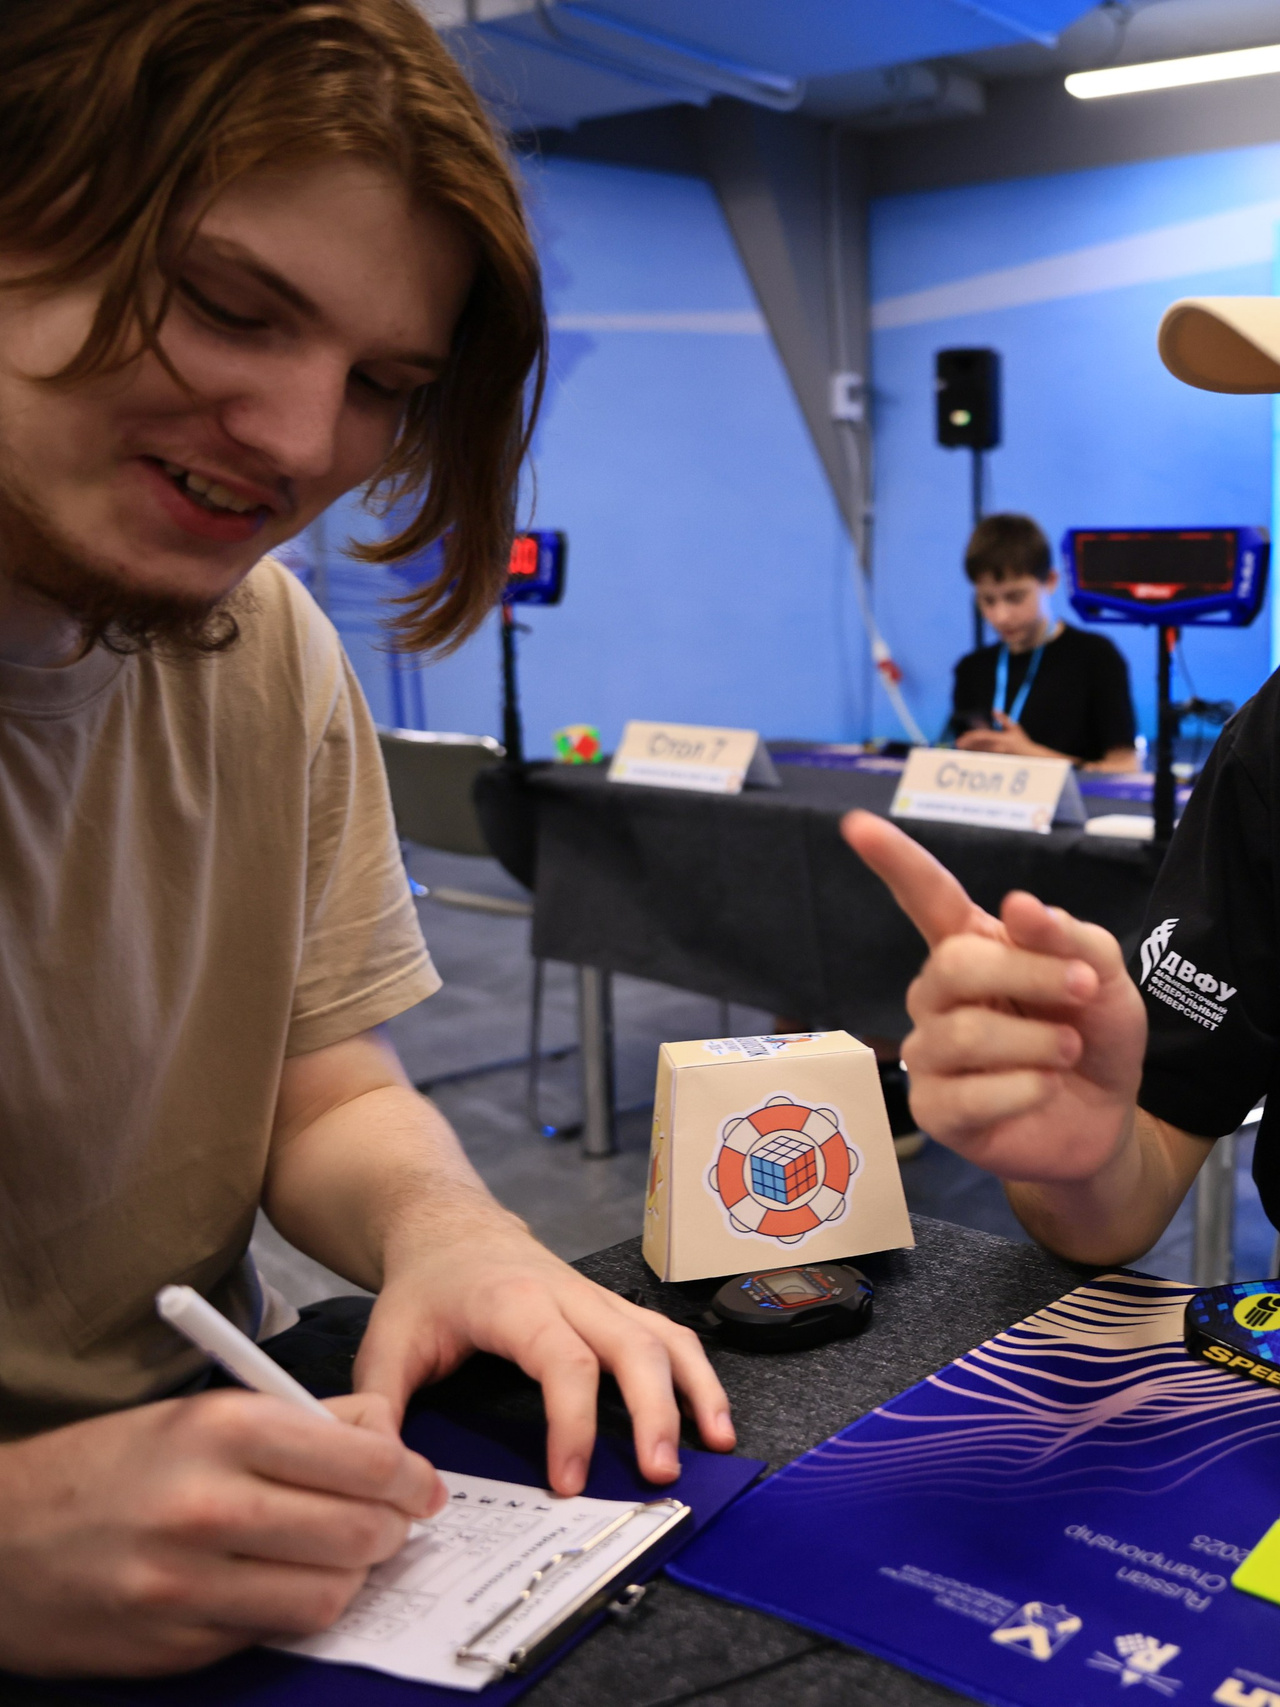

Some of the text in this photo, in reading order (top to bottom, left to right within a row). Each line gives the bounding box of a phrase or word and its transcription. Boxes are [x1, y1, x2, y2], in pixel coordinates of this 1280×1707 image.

[1009, 768, 1030, 796] 8
[1150, 976, 1224, 1023] ФЕДЕРАЛЬНЫЙ
[1154, 968, 1228, 1015] ДАЛЬНЕВОСТОЧНЫЙ
[1159, 950, 1238, 1002] ДВФУ
[1146, 983, 1219, 1031] УНИВЕРСИТЕТ
[1063, 1523, 1228, 1593] Championship
[1189, 1534, 1253, 1567] 2025
[1116, 1565, 1212, 1612] Russian
